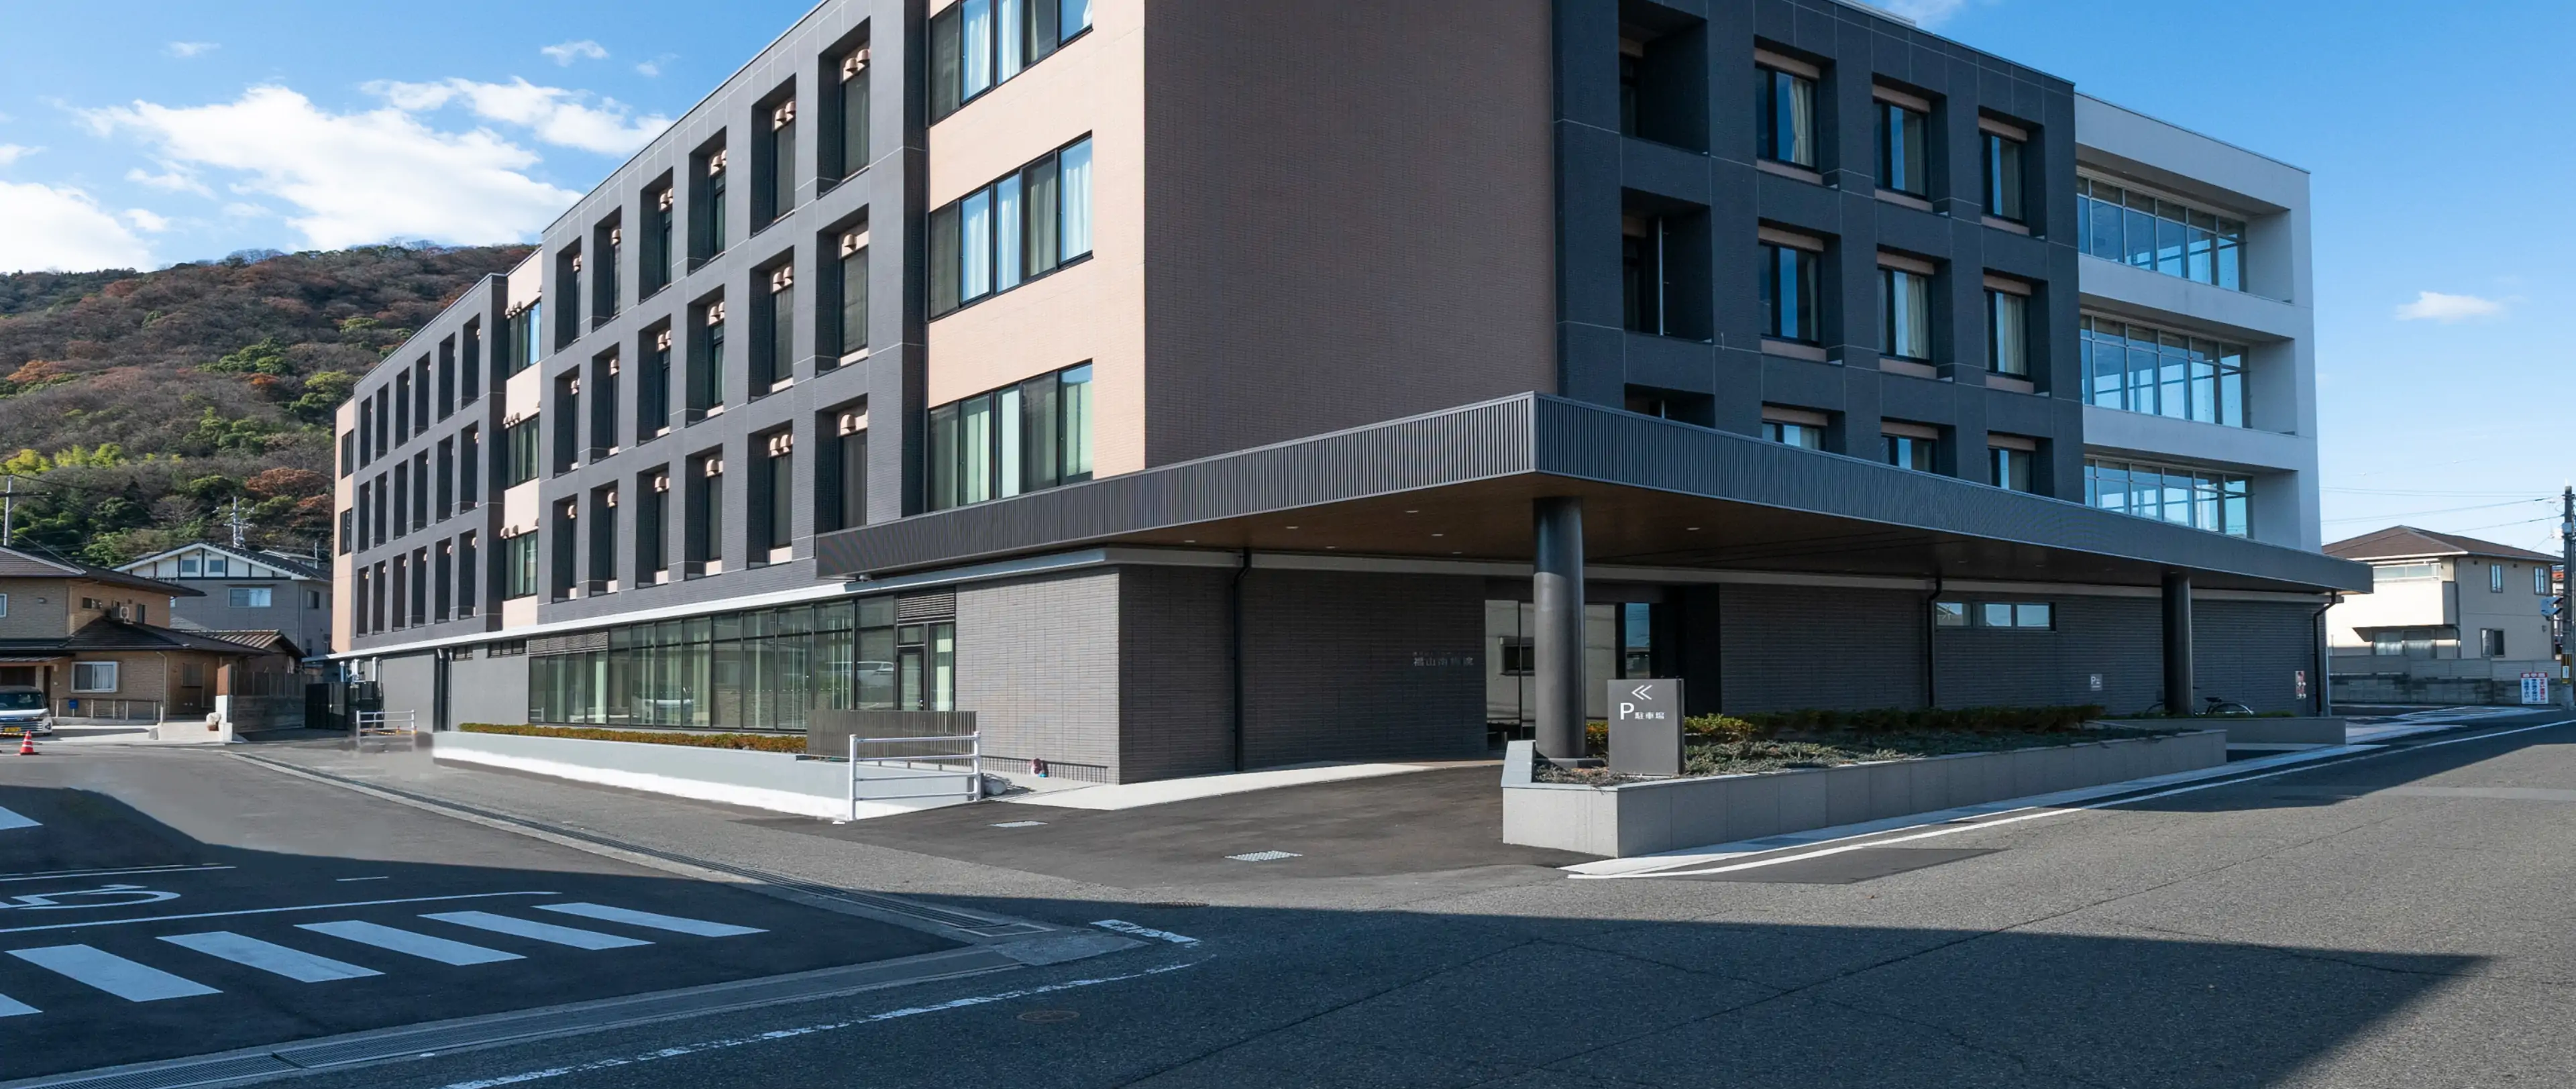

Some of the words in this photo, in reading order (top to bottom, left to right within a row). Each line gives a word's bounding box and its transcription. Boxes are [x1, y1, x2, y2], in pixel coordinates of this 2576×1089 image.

[1413, 657, 1474, 667] 福山南院
[1620, 702, 1635, 720] P
